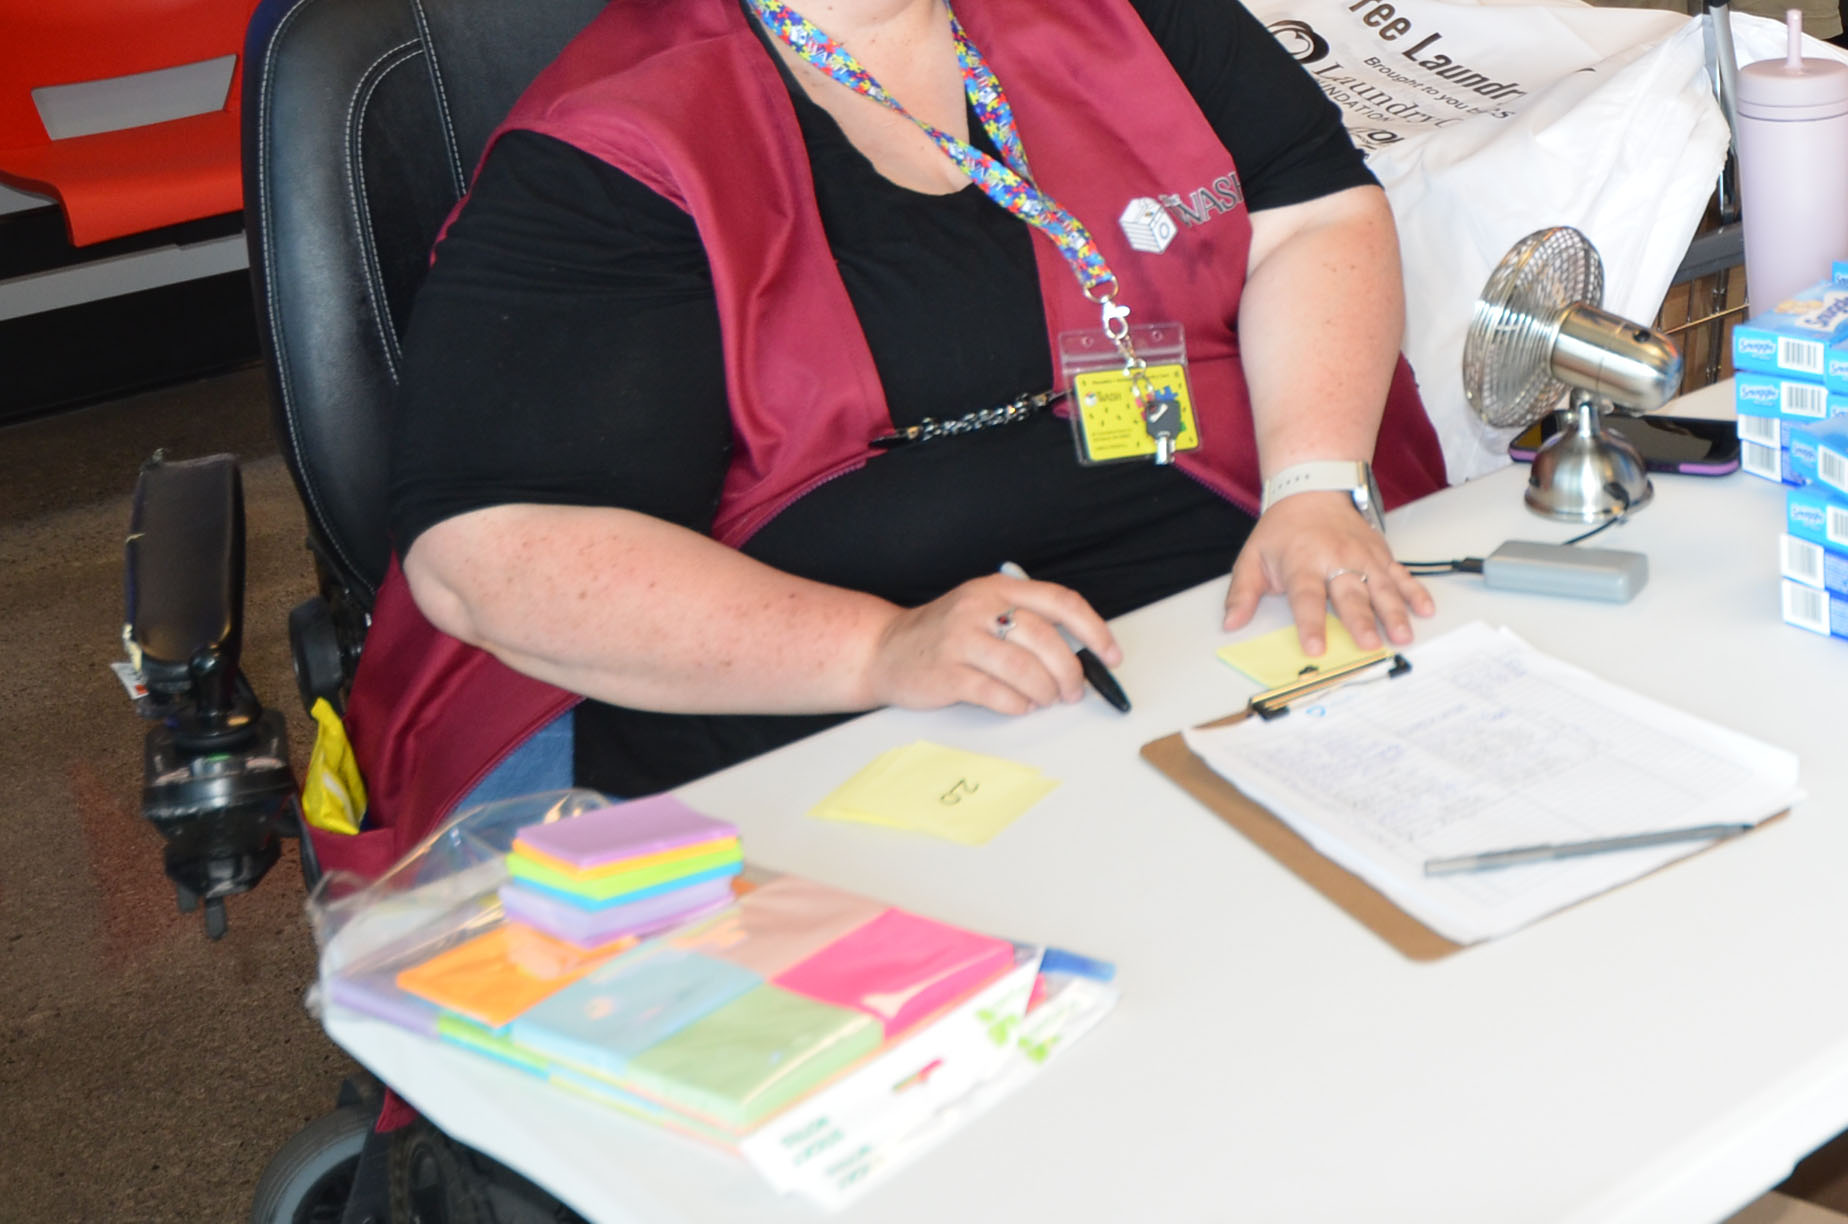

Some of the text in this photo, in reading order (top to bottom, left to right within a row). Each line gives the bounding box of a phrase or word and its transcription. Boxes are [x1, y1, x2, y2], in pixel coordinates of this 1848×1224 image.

[1364, 57, 1425, 90] Brought
[1422, 84, 1440, 96] to
[1439, 93, 1467, 111] you
[1402, 32, 1527, 103] Laundr
